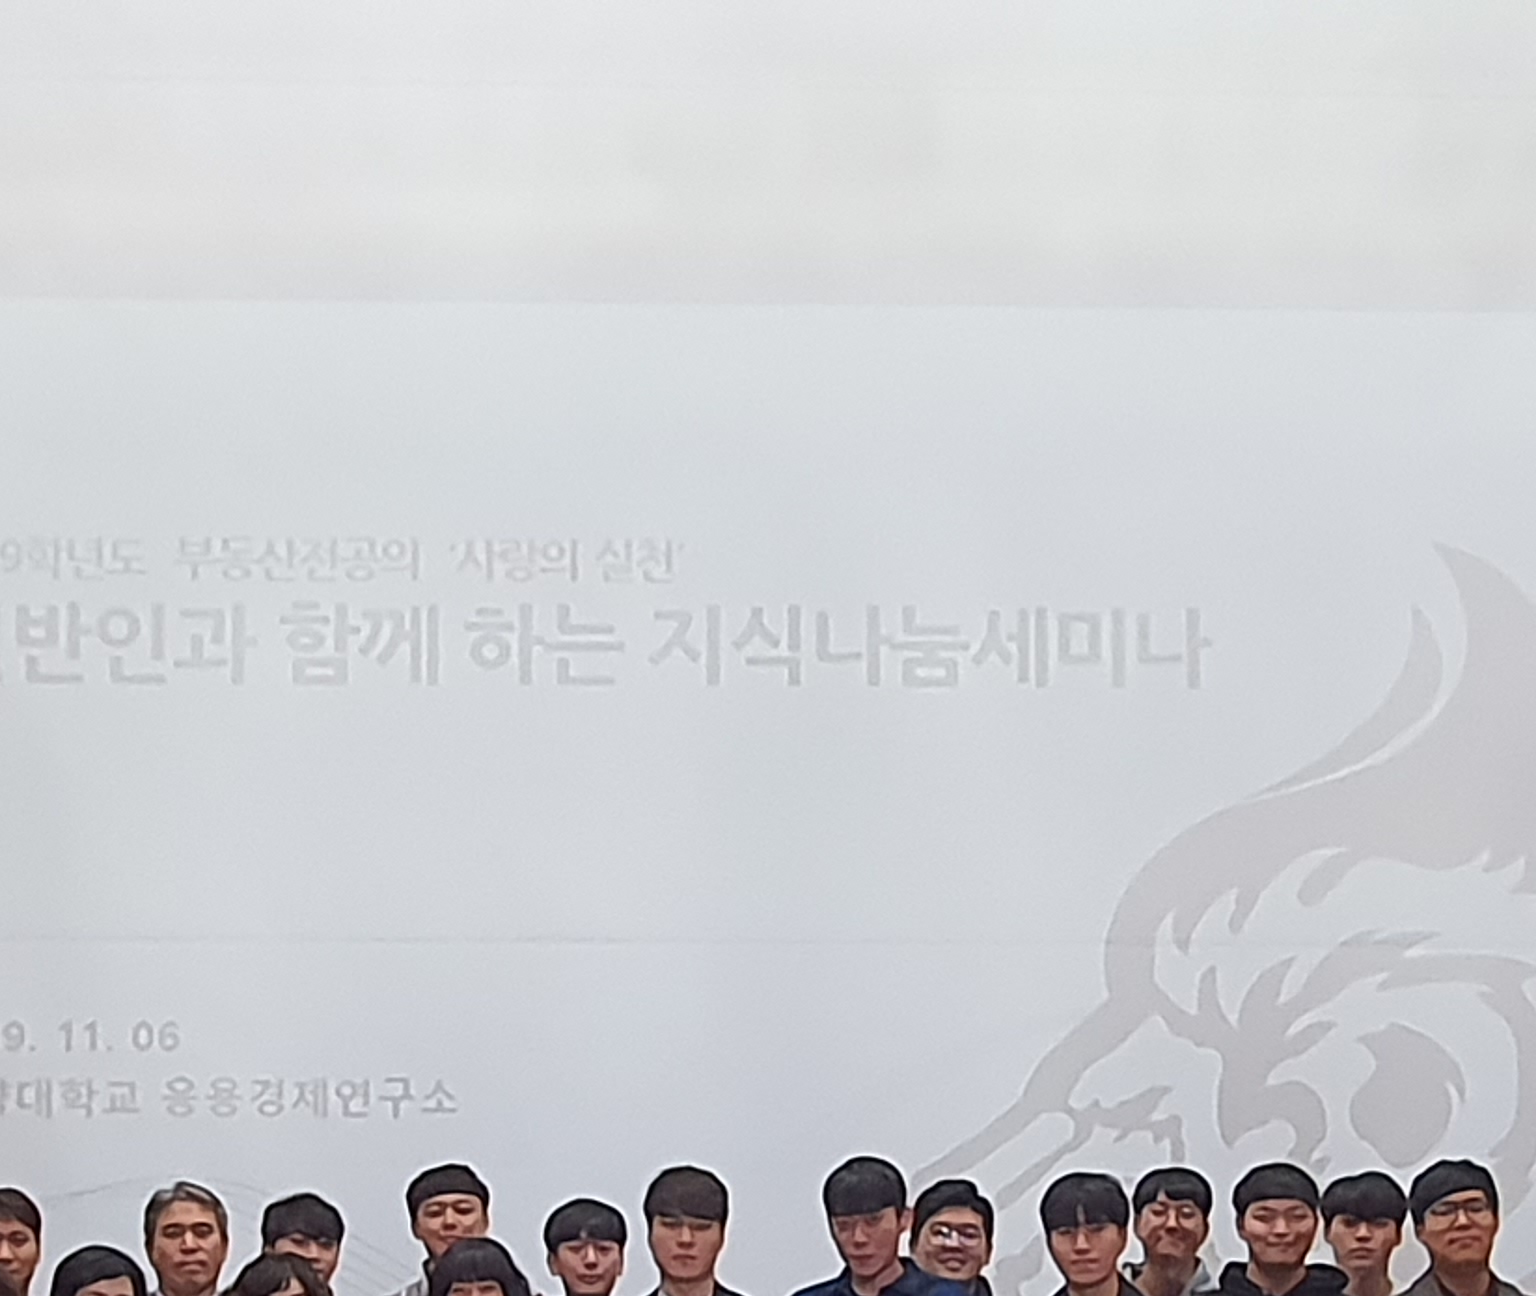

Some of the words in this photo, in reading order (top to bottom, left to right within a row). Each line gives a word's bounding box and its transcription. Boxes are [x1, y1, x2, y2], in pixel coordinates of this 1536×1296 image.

[174, 536, 420, 583] 부동산전공의
[278, 600, 440, 687] 함께
[463, 602, 626, 687] 하는
[647, 603, 1214, 691] 지식나눔세미나
[57, 1019, 114, 1054] 11.
[131, 1019, 181, 1053] 06
[160, 1075, 460, 1121] 응용경제연구소
